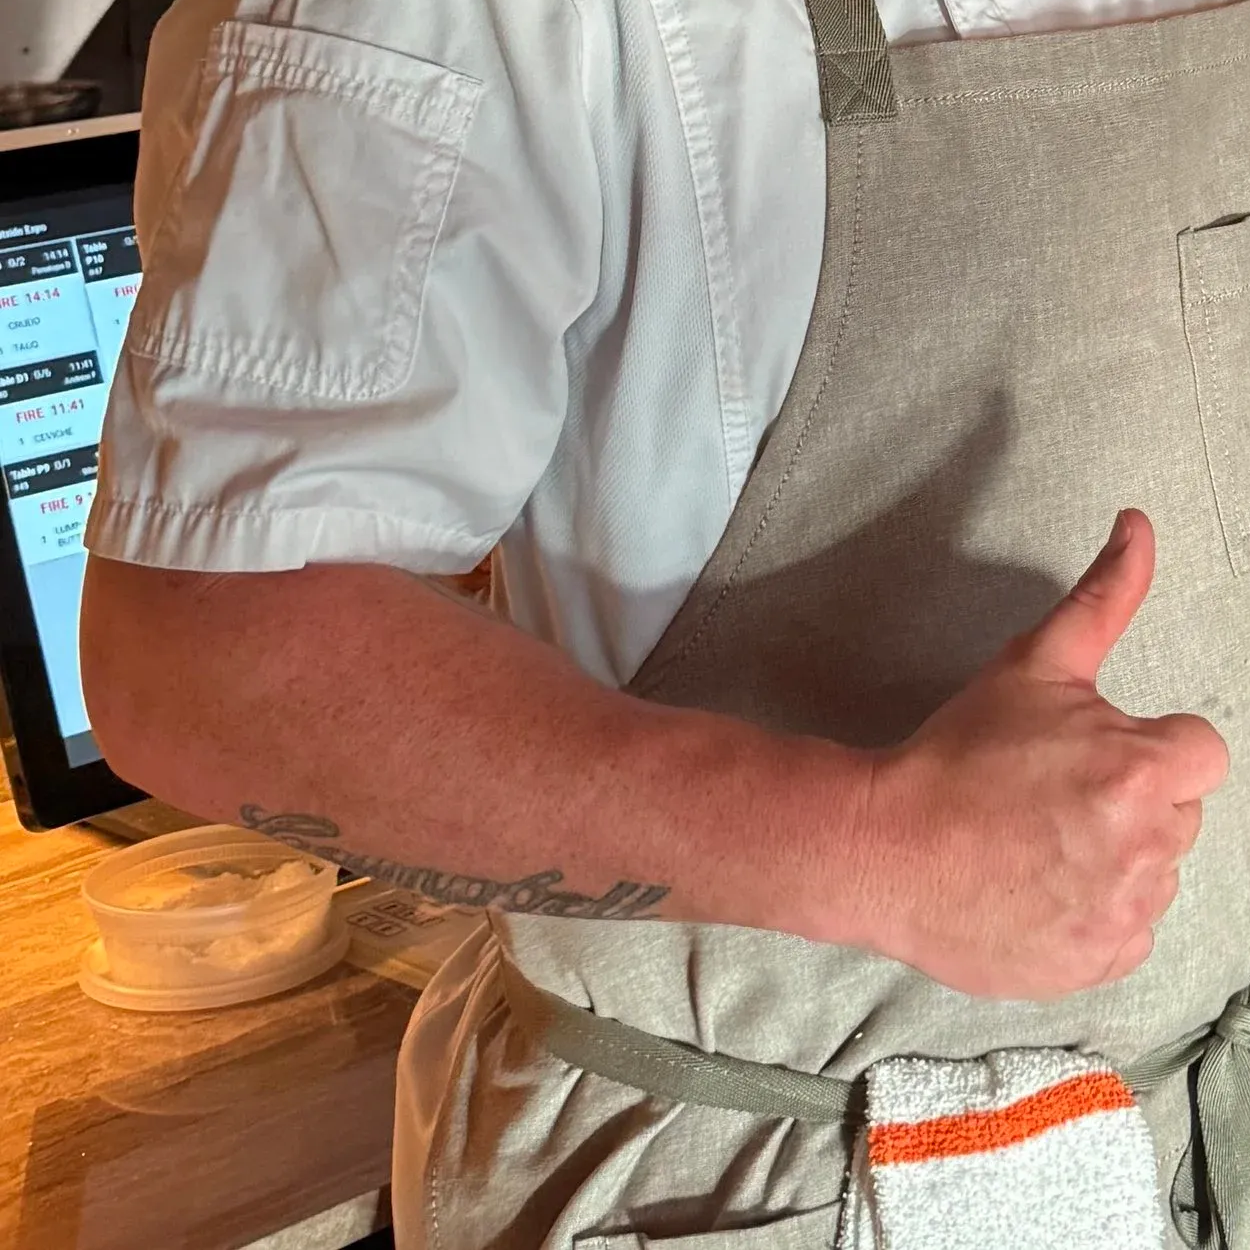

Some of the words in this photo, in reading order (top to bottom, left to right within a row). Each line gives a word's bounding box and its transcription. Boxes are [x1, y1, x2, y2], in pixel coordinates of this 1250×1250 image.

[25, 287, 61, 304] 14:14
[8, 316, 41, 331] CRUDO
[16, 407, 46, 424] FIRE
[51, 398, 85, 417] 11:41
[33, 427, 73, 444] CEVICHE
[10, 466, 37, 481] Table
[40, 497, 70, 514] FIRE
